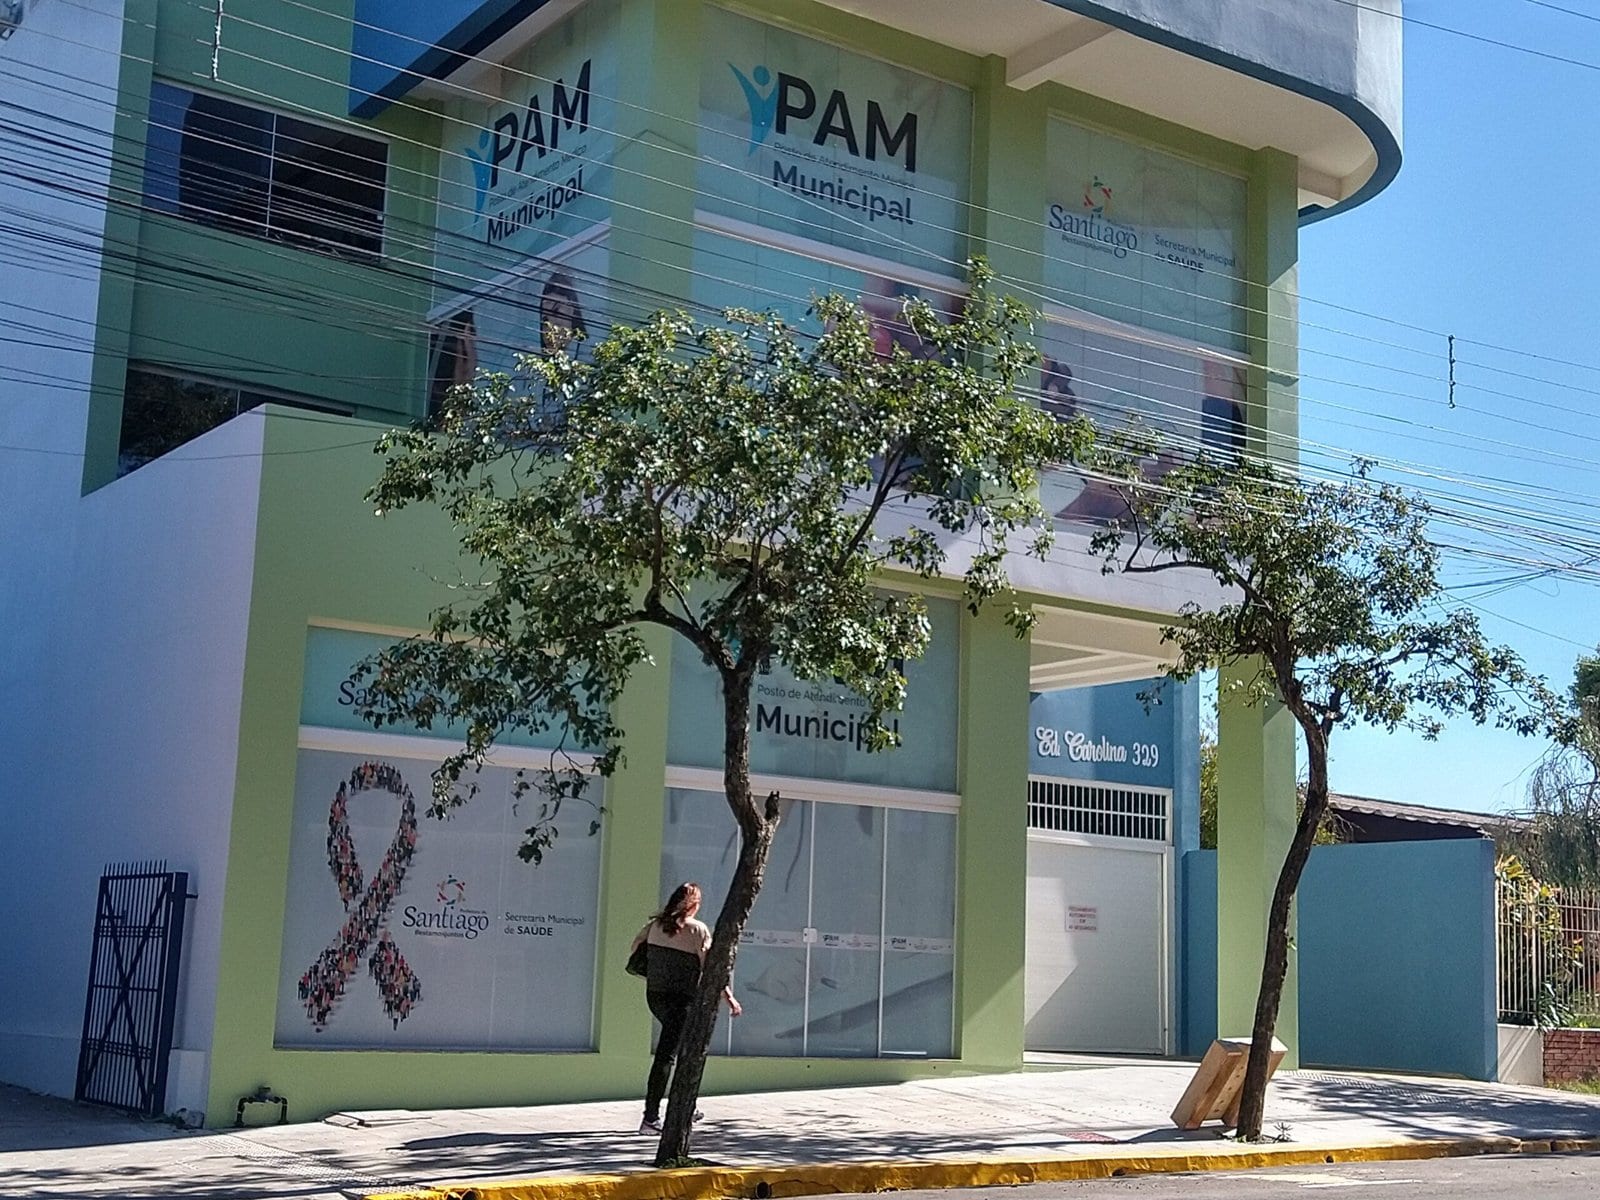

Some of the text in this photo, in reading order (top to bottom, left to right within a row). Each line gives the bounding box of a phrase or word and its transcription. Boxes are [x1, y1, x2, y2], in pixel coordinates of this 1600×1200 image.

[491, 58, 592, 188] PAM
[775, 71, 918, 173] PAM
[487, 164, 585, 246] Municipal
[772, 160, 914, 225] Municipal
[1049, 204, 1138, 259] Santiago
[1197, 246, 1236, 268] Municipal
[757, 684, 786, 698] Posto
[788, 687, 801, 700] de
[756, 703, 902, 752] Municipl
[1064, 730, 1128, 763] Carolina
[1132, 742, 1159, 768] 329
[402, 905, 489, 940] Santiago
[504, 926, 515, 936] de
[505, 911, 585, 925] Secretaria Municipal
